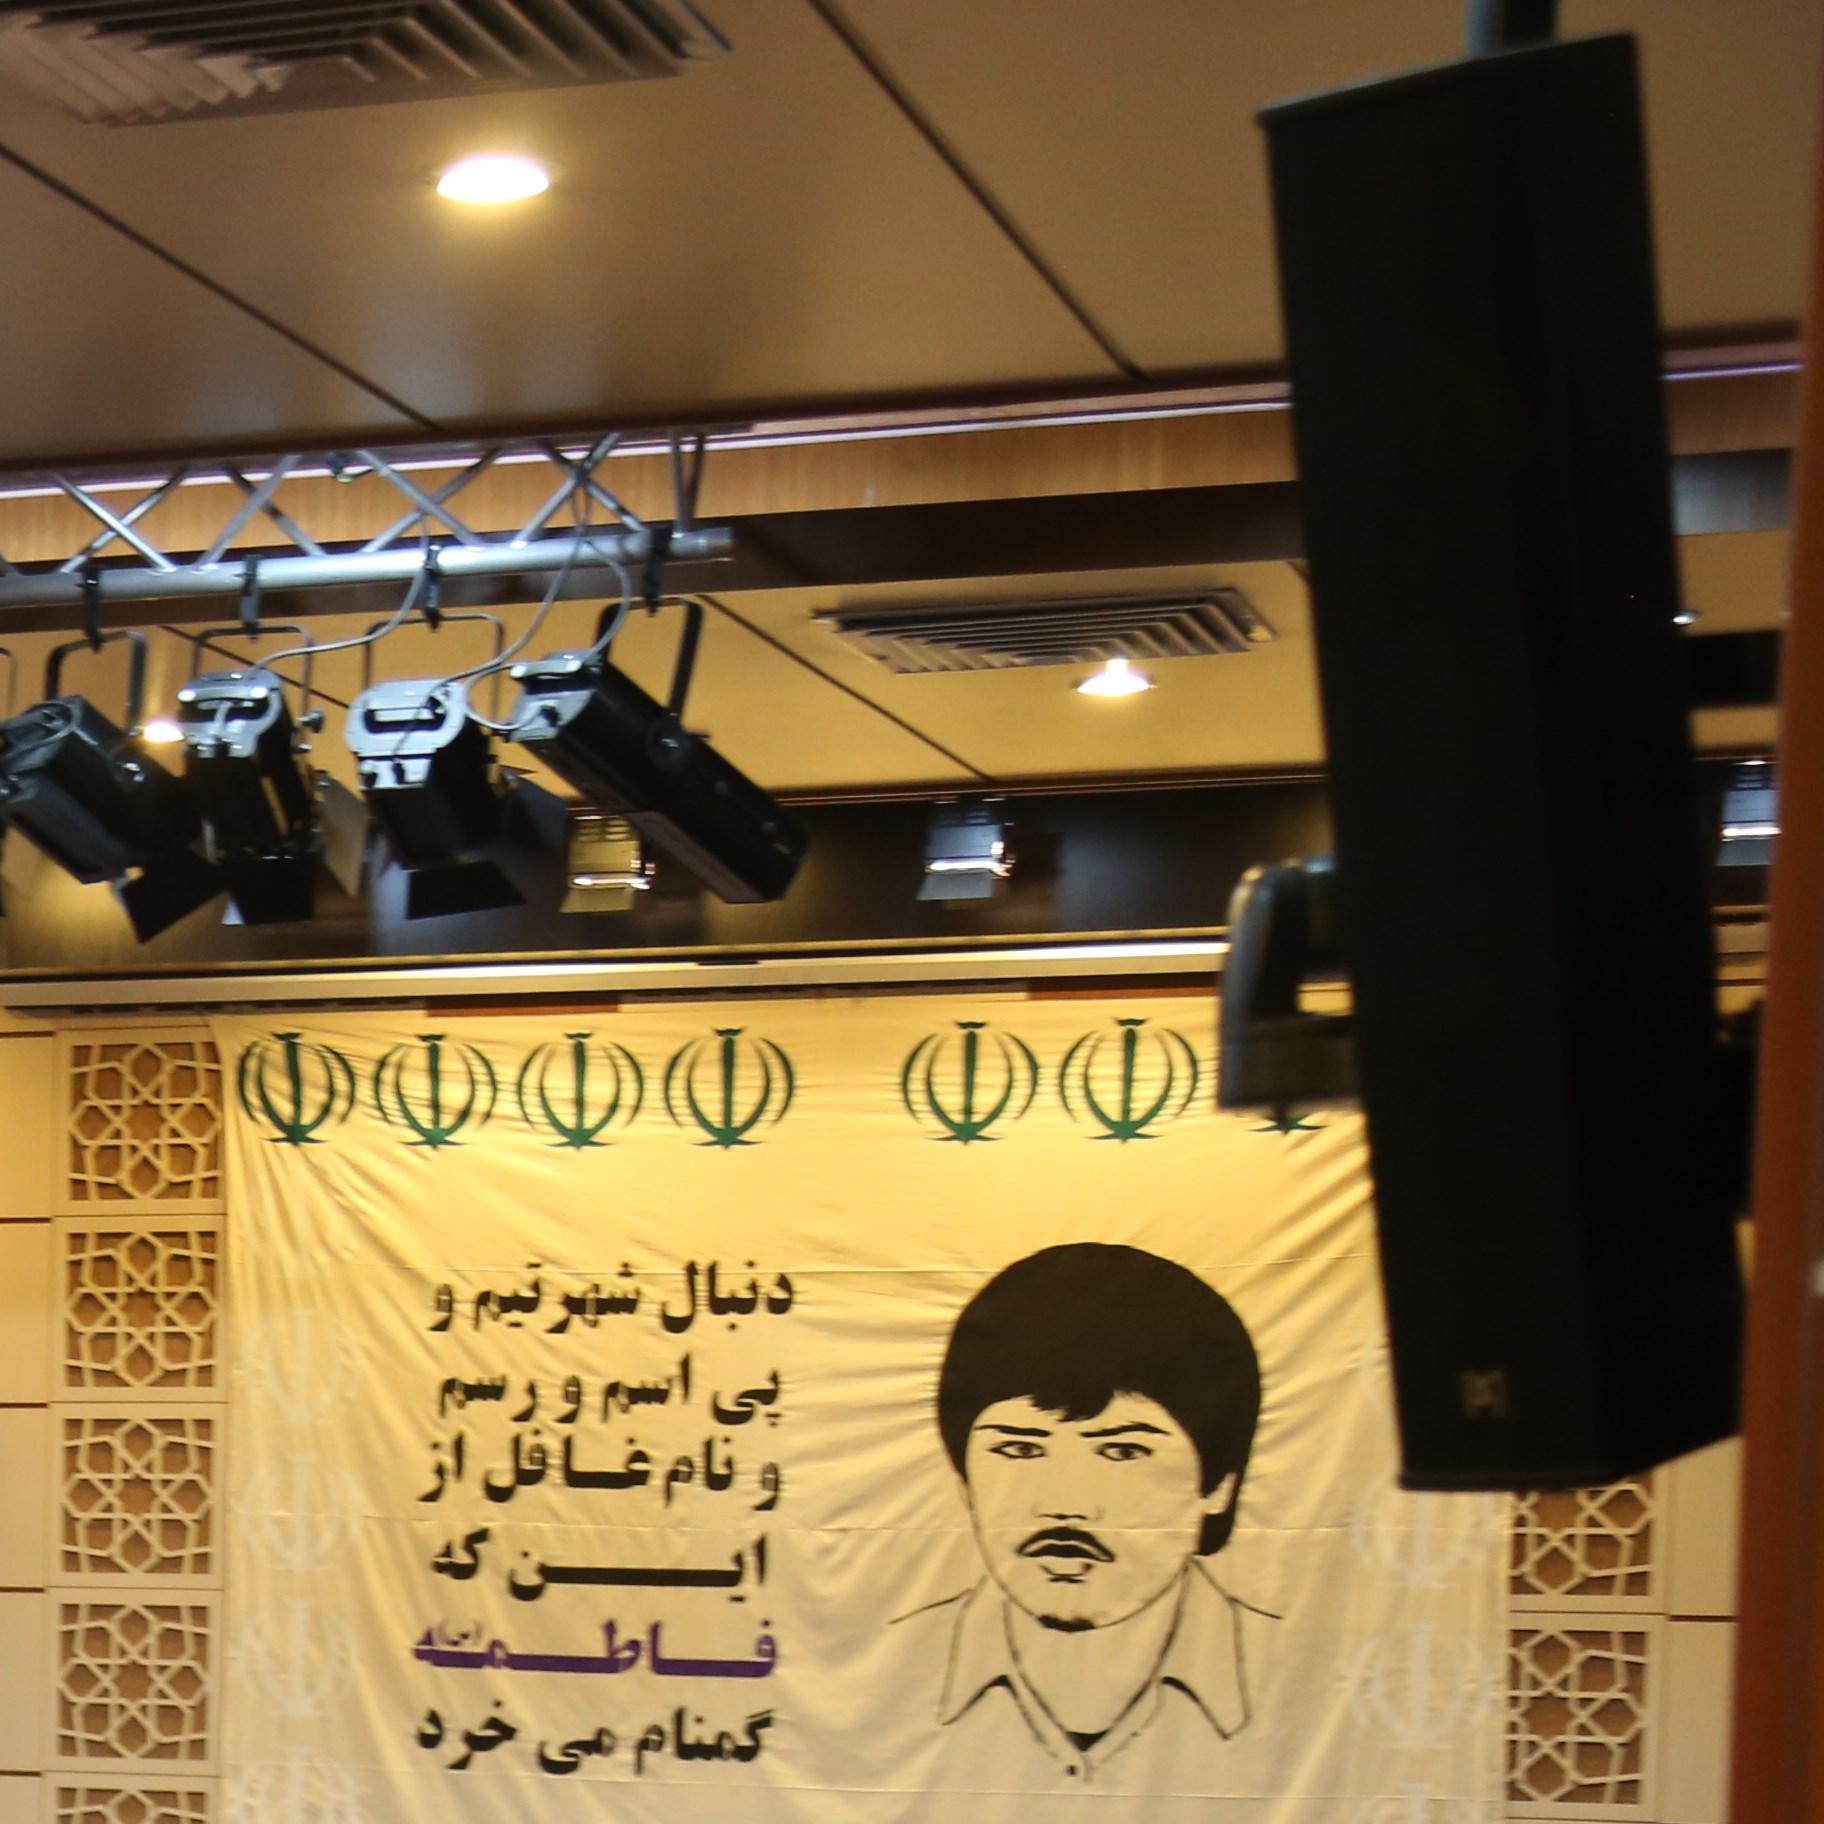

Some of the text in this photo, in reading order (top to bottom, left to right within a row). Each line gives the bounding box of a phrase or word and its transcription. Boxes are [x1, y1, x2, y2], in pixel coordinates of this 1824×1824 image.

[428, 1283, 456, 1332] و
[661, 1260, 794, 1334] دنبال
[440, 1374, 538, 1423] رسم
[555, 1375, 582, 1424] و
[602, 1352, 692, 1422] اسم
[417, 1428, 781, 1512] و نام غافل از
[431, 1527, 491, 1581] که
[416, 1699, 774, 1775] گمنام می خرد
